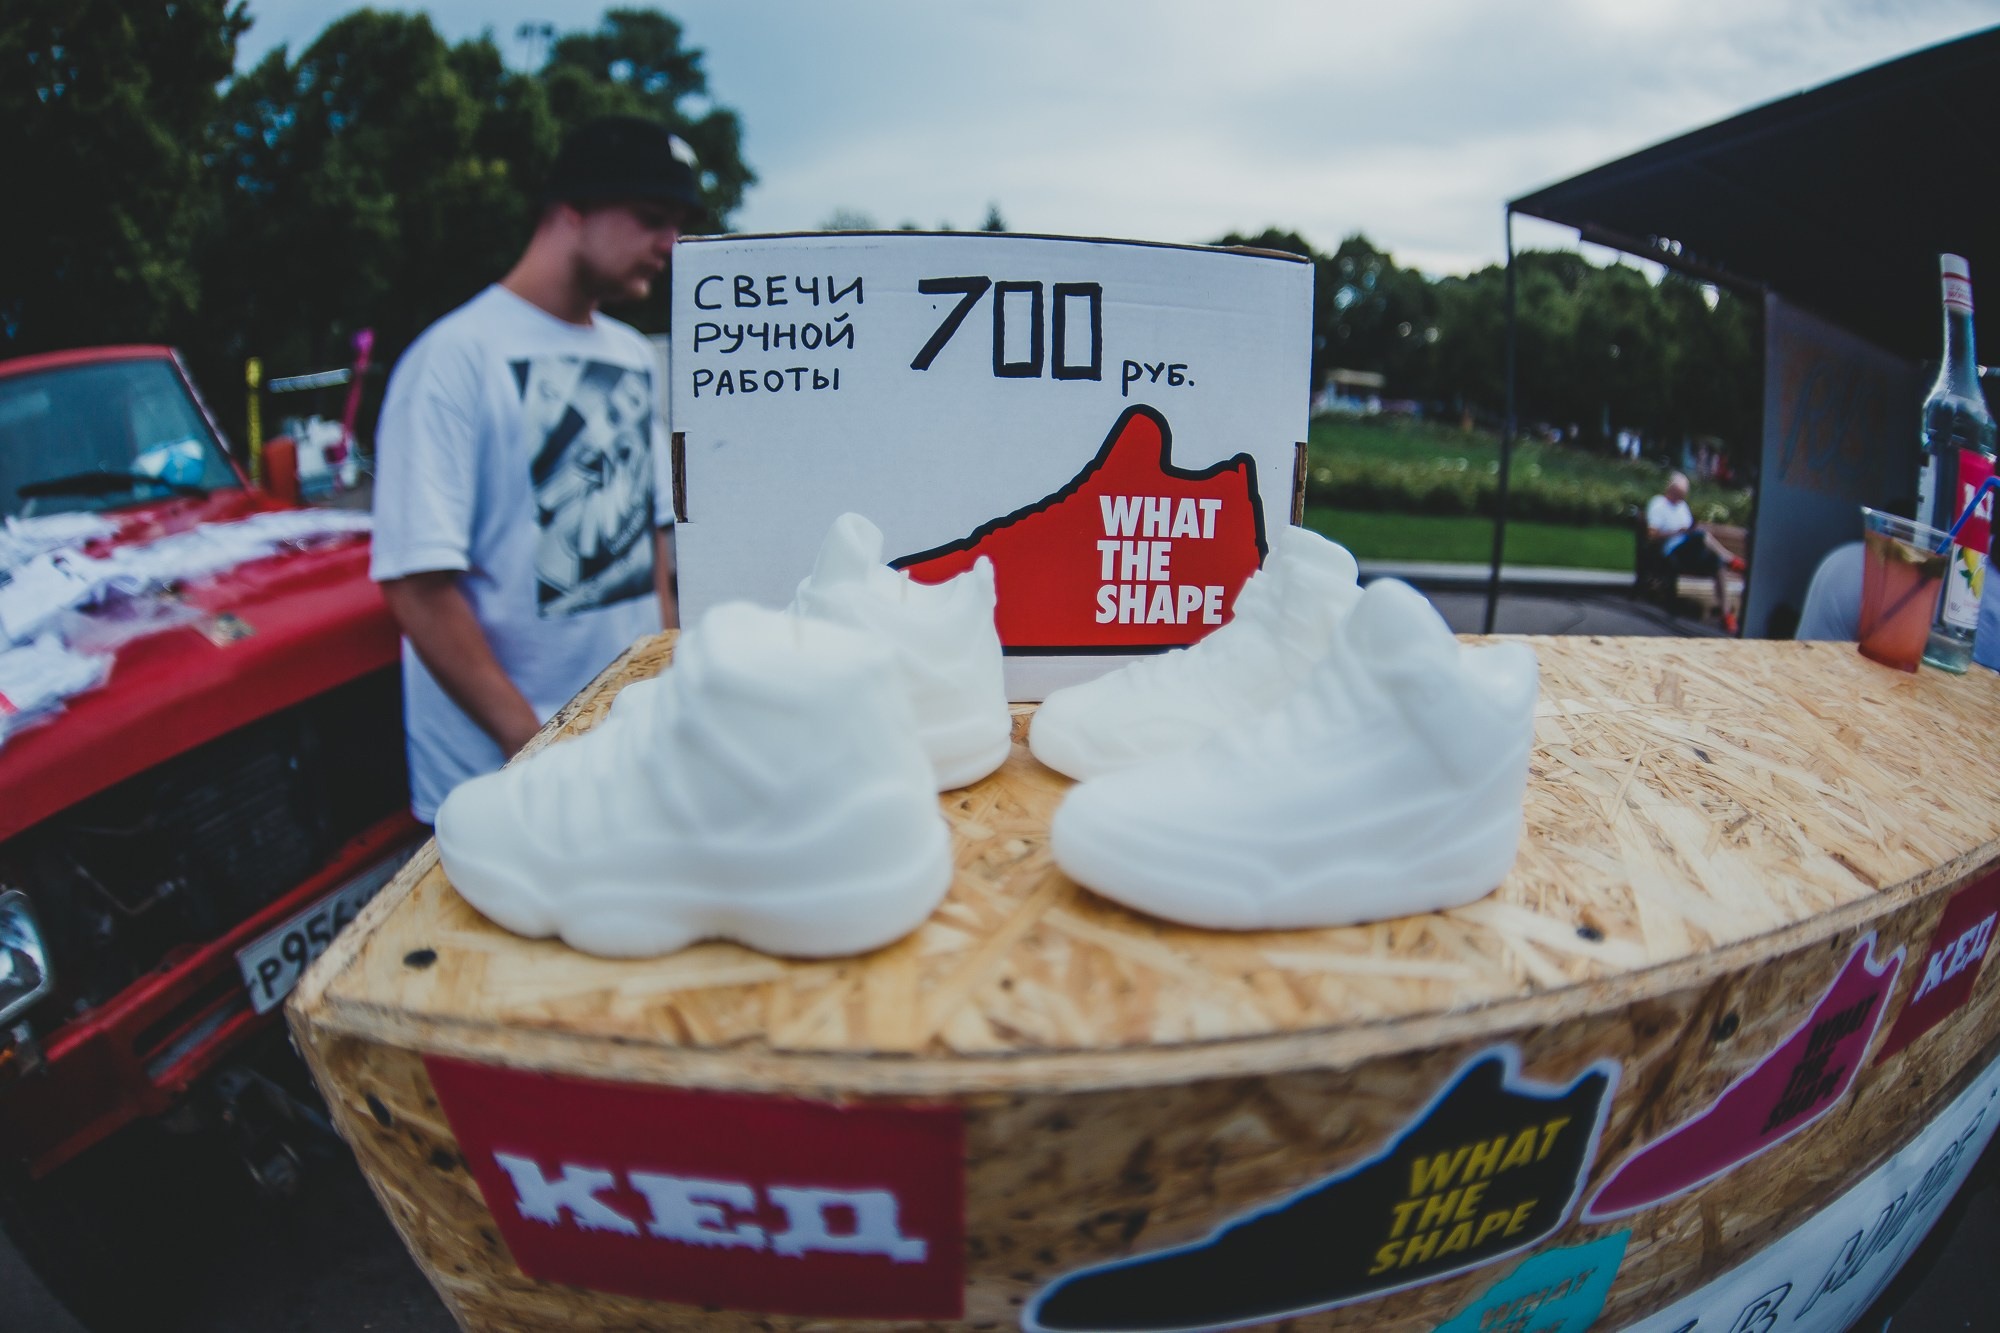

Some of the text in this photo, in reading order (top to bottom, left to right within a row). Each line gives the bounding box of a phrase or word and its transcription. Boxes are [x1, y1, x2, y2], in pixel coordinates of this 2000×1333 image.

[693, 274, 865, 310] СВЕЧИ
[692, 312, 855, 354] РУЧНОЙ
[909, 275, 1197, 396] 700 РУБ.
[692, 367, 840, 398] РАБОТЫ
[1098, 495, 1223, 539] WHAT
[1096, 539, 1173, 582] THE
[1095, 583, 1226, 627] SHAPE
[1409, 1115, 1572, 1198] WHAT
[1389, 1179, 1492, 1240] THE
[1367, 1198, 1539, 1277] SHAPE
